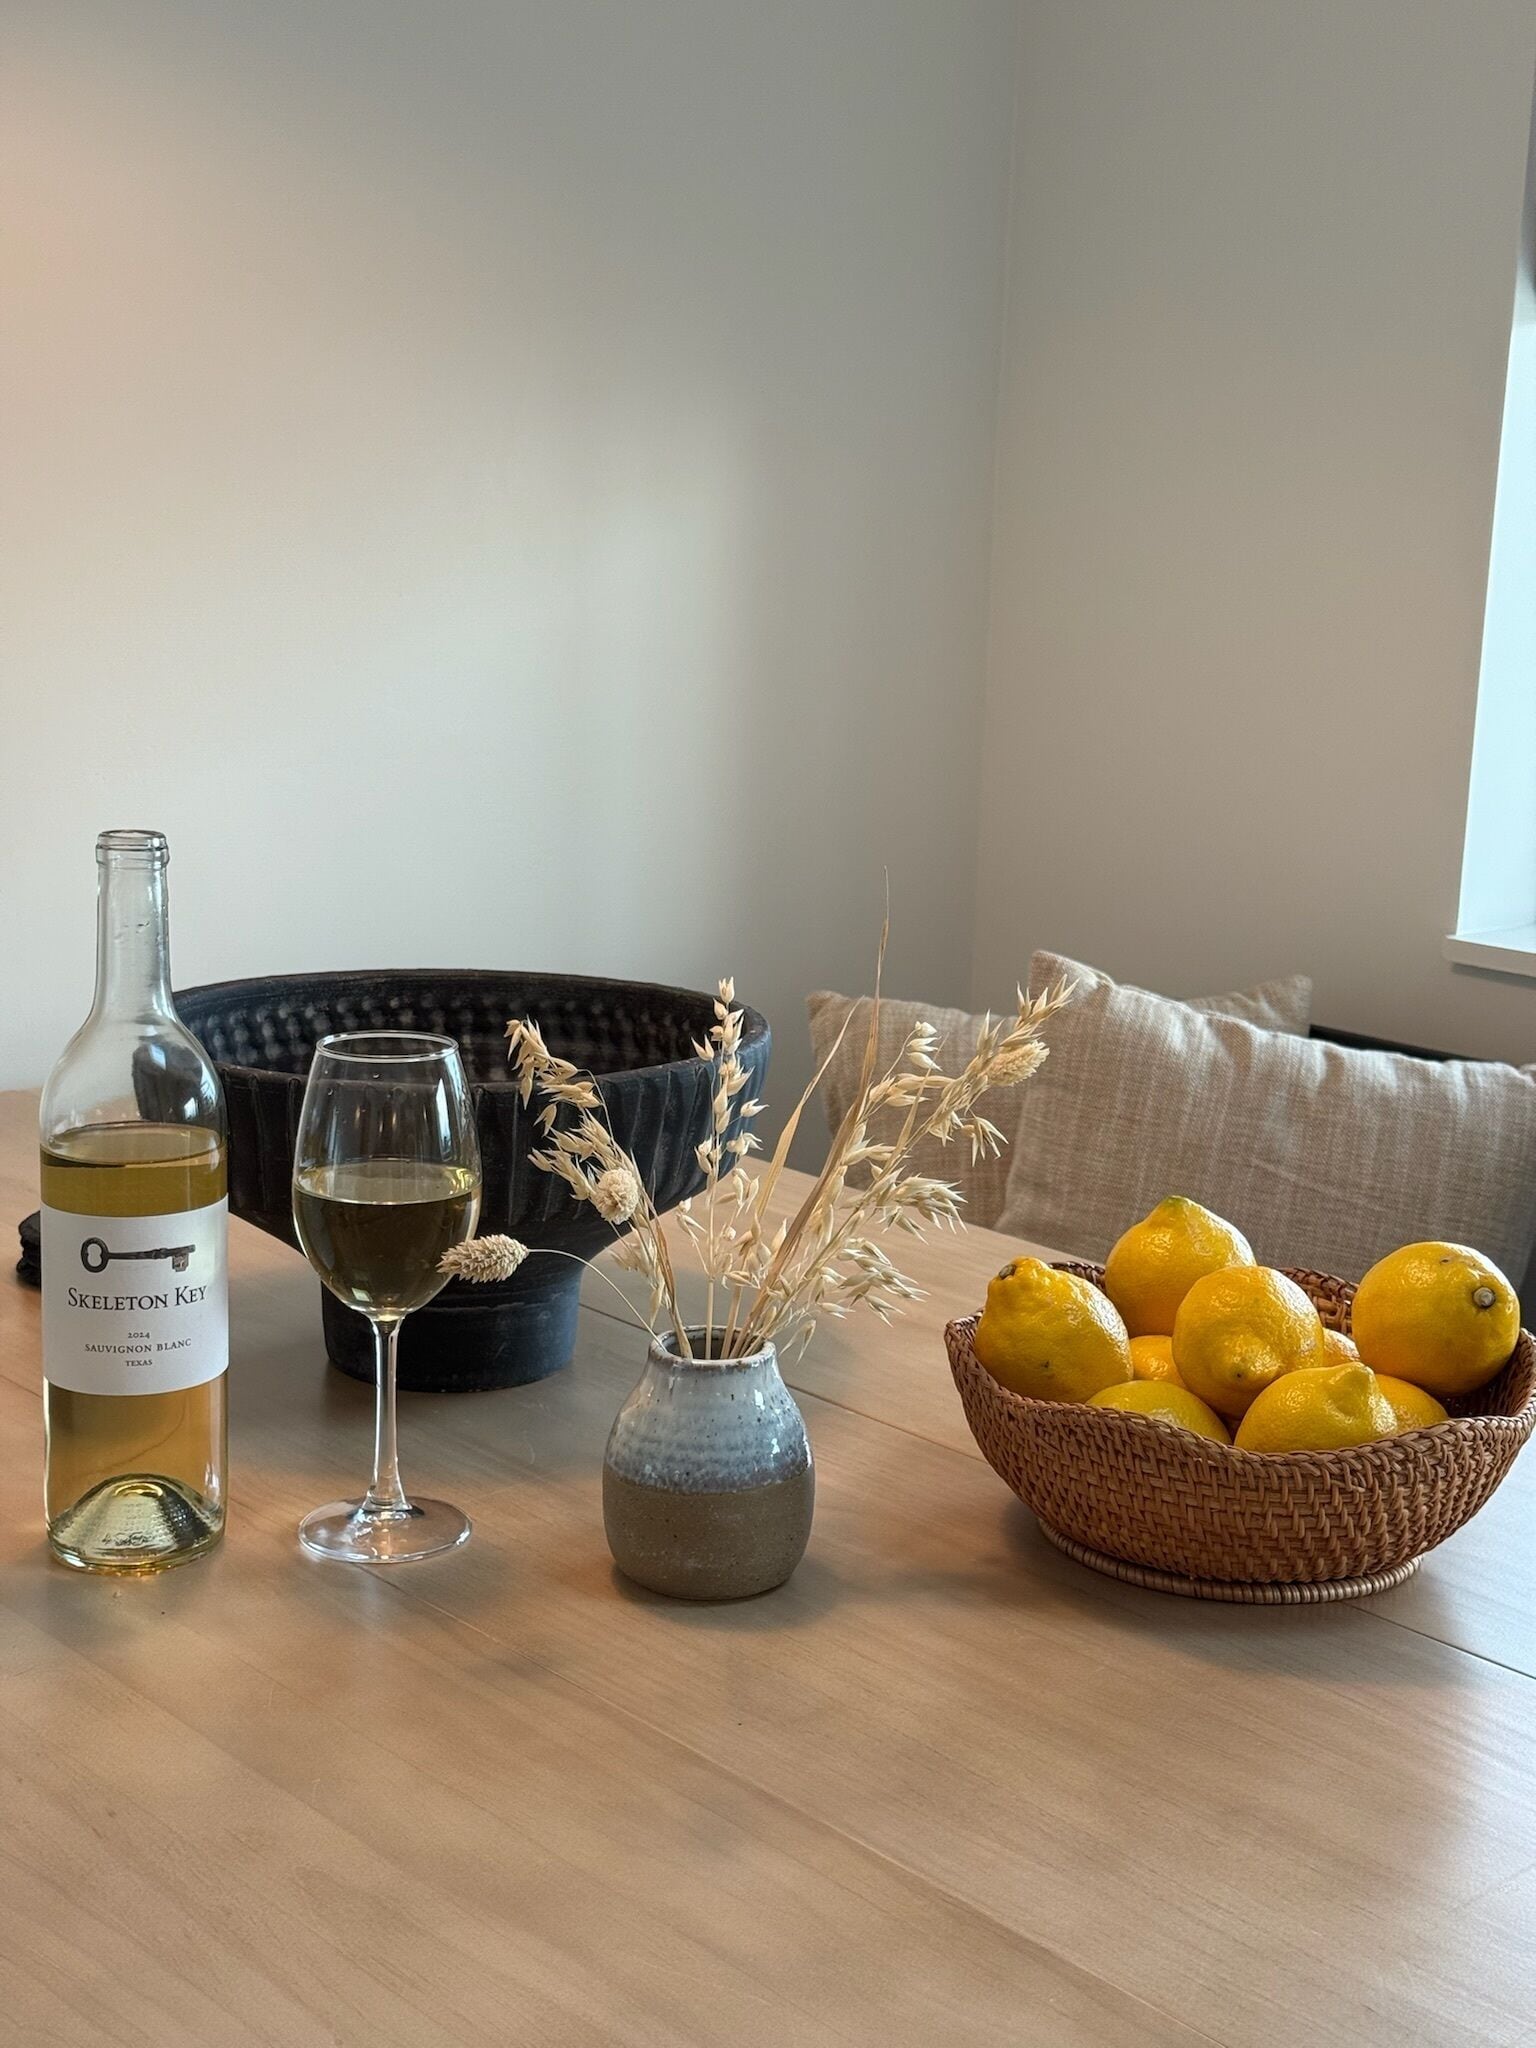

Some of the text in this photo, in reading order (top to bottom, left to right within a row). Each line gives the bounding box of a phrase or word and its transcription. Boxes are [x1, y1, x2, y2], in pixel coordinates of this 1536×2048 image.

[68, 1285, 208, 1311] SKELETON KEY
[127, 1331, 150, 1339] 2024
[85, 1338, 192, 1354] SAUVIGNON BLANC
[126, 1359, 153, 1367] TEXAS
